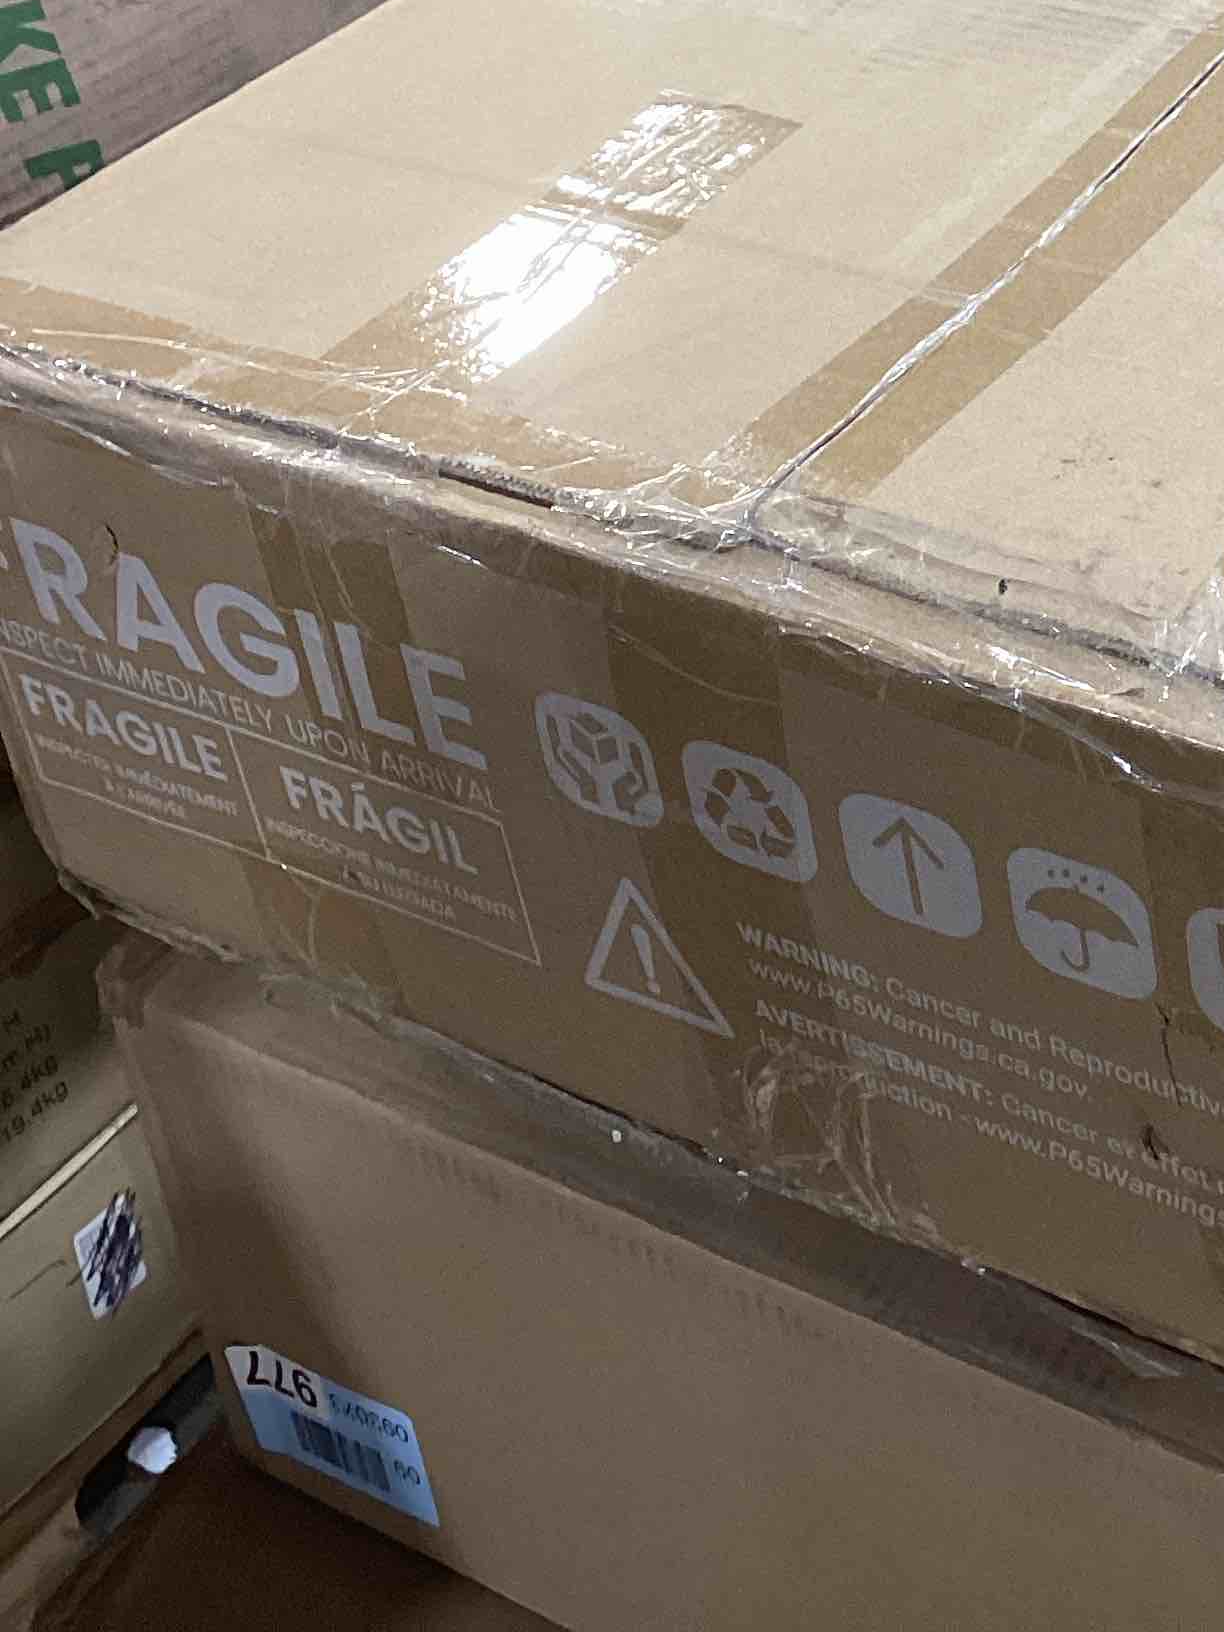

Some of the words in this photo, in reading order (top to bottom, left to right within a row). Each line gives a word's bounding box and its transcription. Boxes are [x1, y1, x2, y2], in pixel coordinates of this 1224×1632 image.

[0, 515, 488, 770] RAGILE
[0, 618, 87, 671] NSPECT
[95, 651, 273, 735] IMMEDIATELY
[285, 713, 370, 767] UPON
[379, 749, 502, 816] ARRIVAL
[19, 672, 228, 782] FRAGILE
[279, 766, 479, 880] FRÁGIL
[735, 920, 880, 992] WARNING:
[885, 976, 982, 1029] Cancer
[989, 1017, 1042, 1052] and
[1000, 1091, 1098, 1145] Cancer
